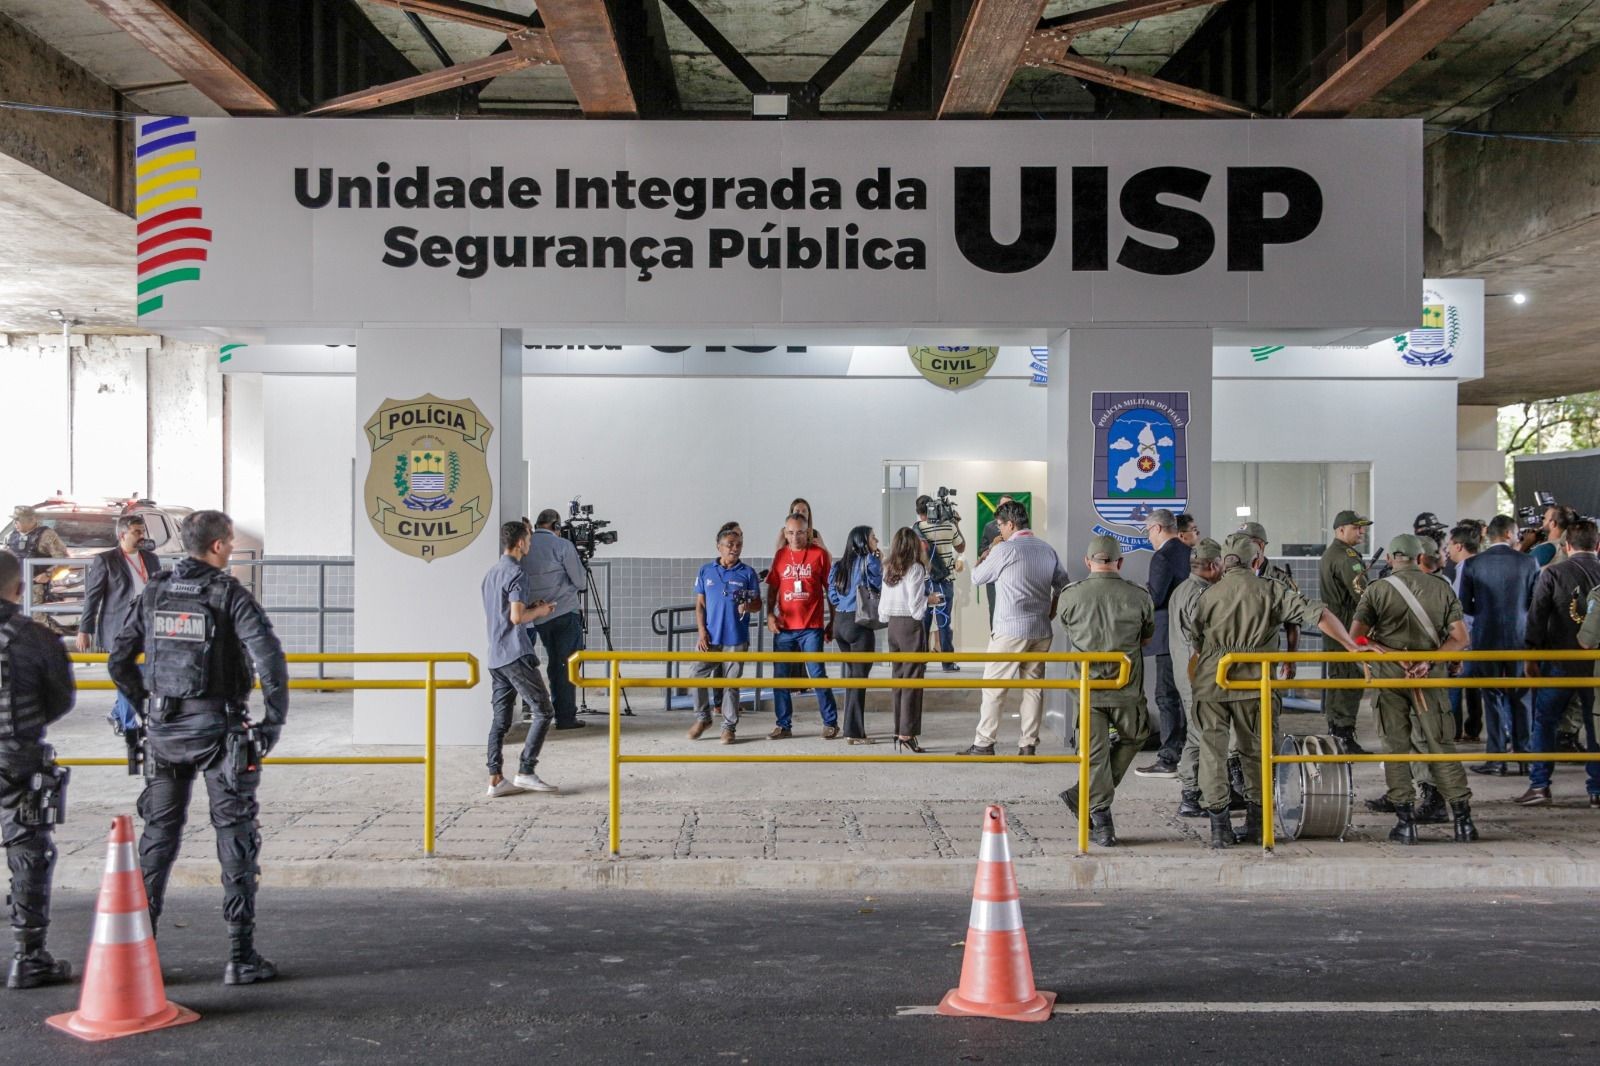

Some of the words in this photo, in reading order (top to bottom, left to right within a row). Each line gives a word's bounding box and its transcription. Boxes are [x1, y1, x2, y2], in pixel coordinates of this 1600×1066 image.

[295, 162, 541, 209] Unidade
[556, 167, 841, 220] Integrada
[856, 167, 927, 210] da
[954, 166, 1323, 275] UISP
[382, 226, 693, 281] Segurança
[709, 222, 926, 270] Pública
[931, 358, 976, 371] CIVIL
[949, 377, 959, 385] PI
[389, 405, 466, 430] POLÍCIA
[1098, 403, 1122, 427] POLÍCIA
[1123, 398, 1156, 406] MILITAR
[1156, 402, 1168, 410] DO
[398, 520, 458, 537] CIVIL
[422, 545, 434, 556] PI
[156, 616, 203, 635] ROCAM
